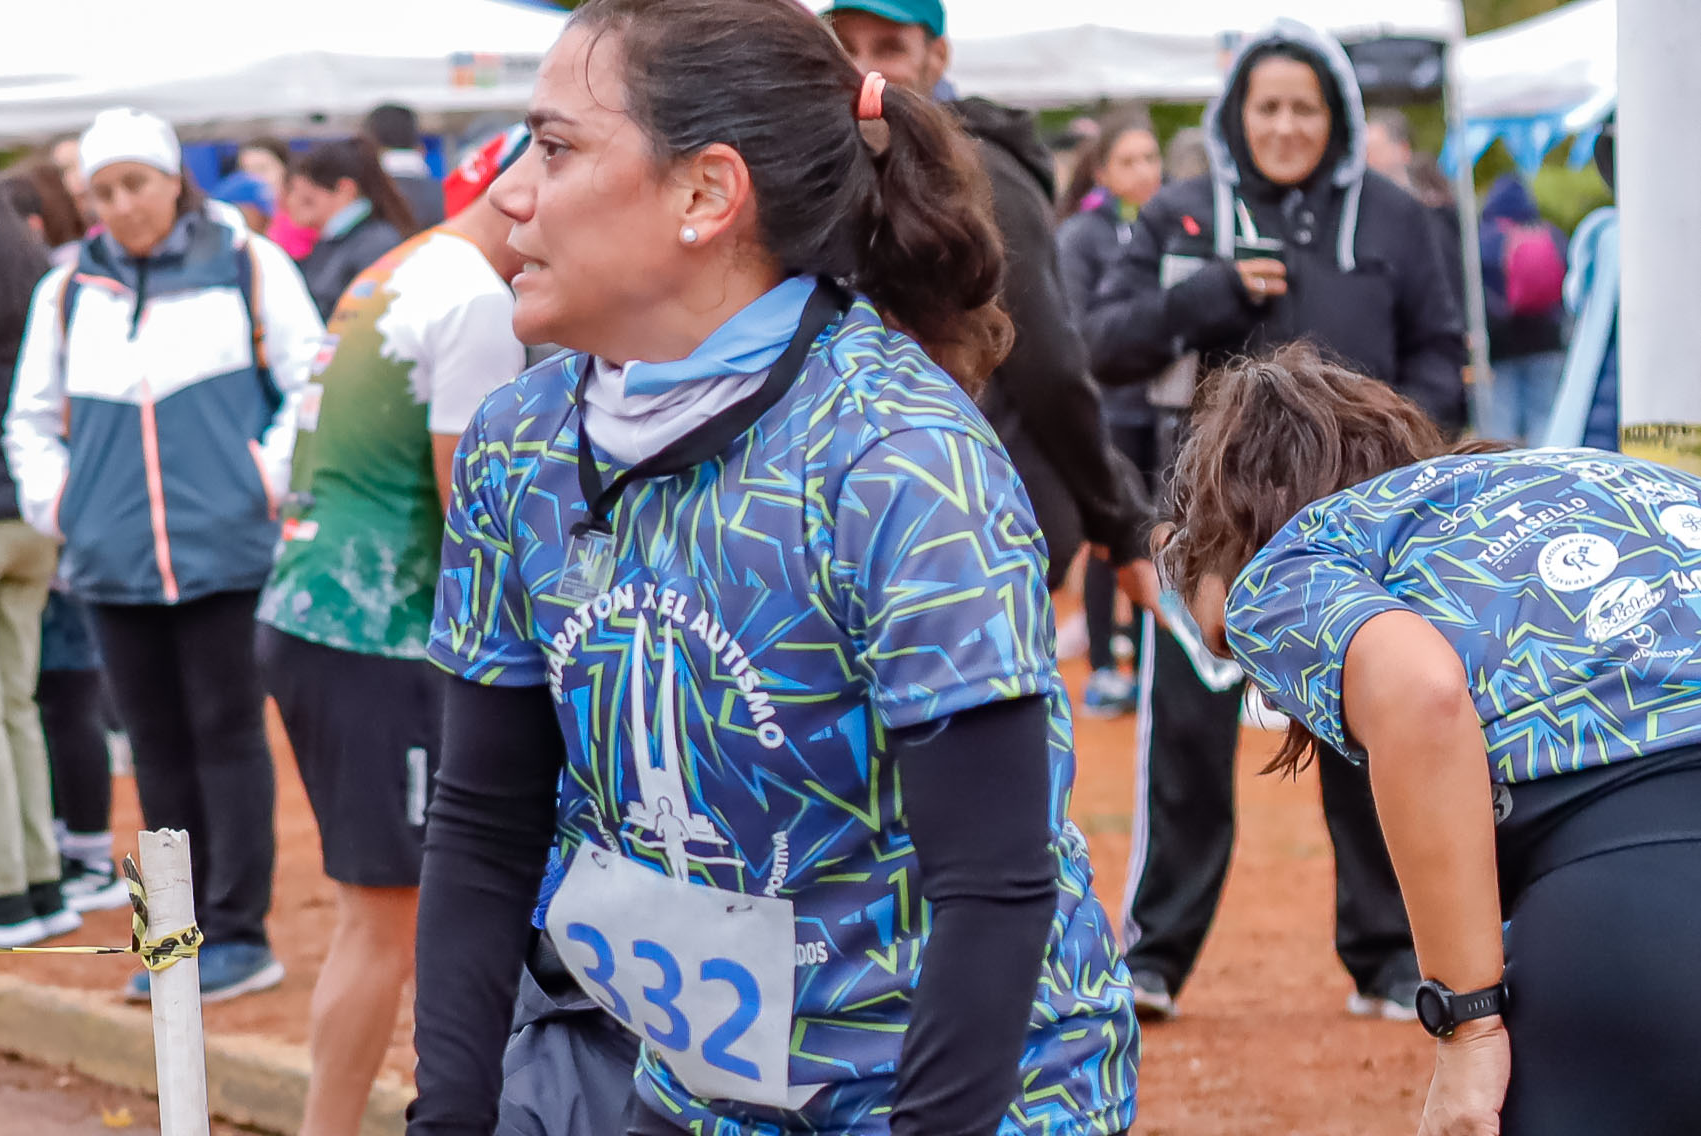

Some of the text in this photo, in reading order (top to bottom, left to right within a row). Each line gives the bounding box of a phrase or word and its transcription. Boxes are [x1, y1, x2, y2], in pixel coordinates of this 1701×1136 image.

[1477, 497, 1589, 565] TOMASELLO
[548, 582, 635, 704] MARATON
[689, 611, 786, 750] AUTISMO
[565, 921, 763, 1083] 332
